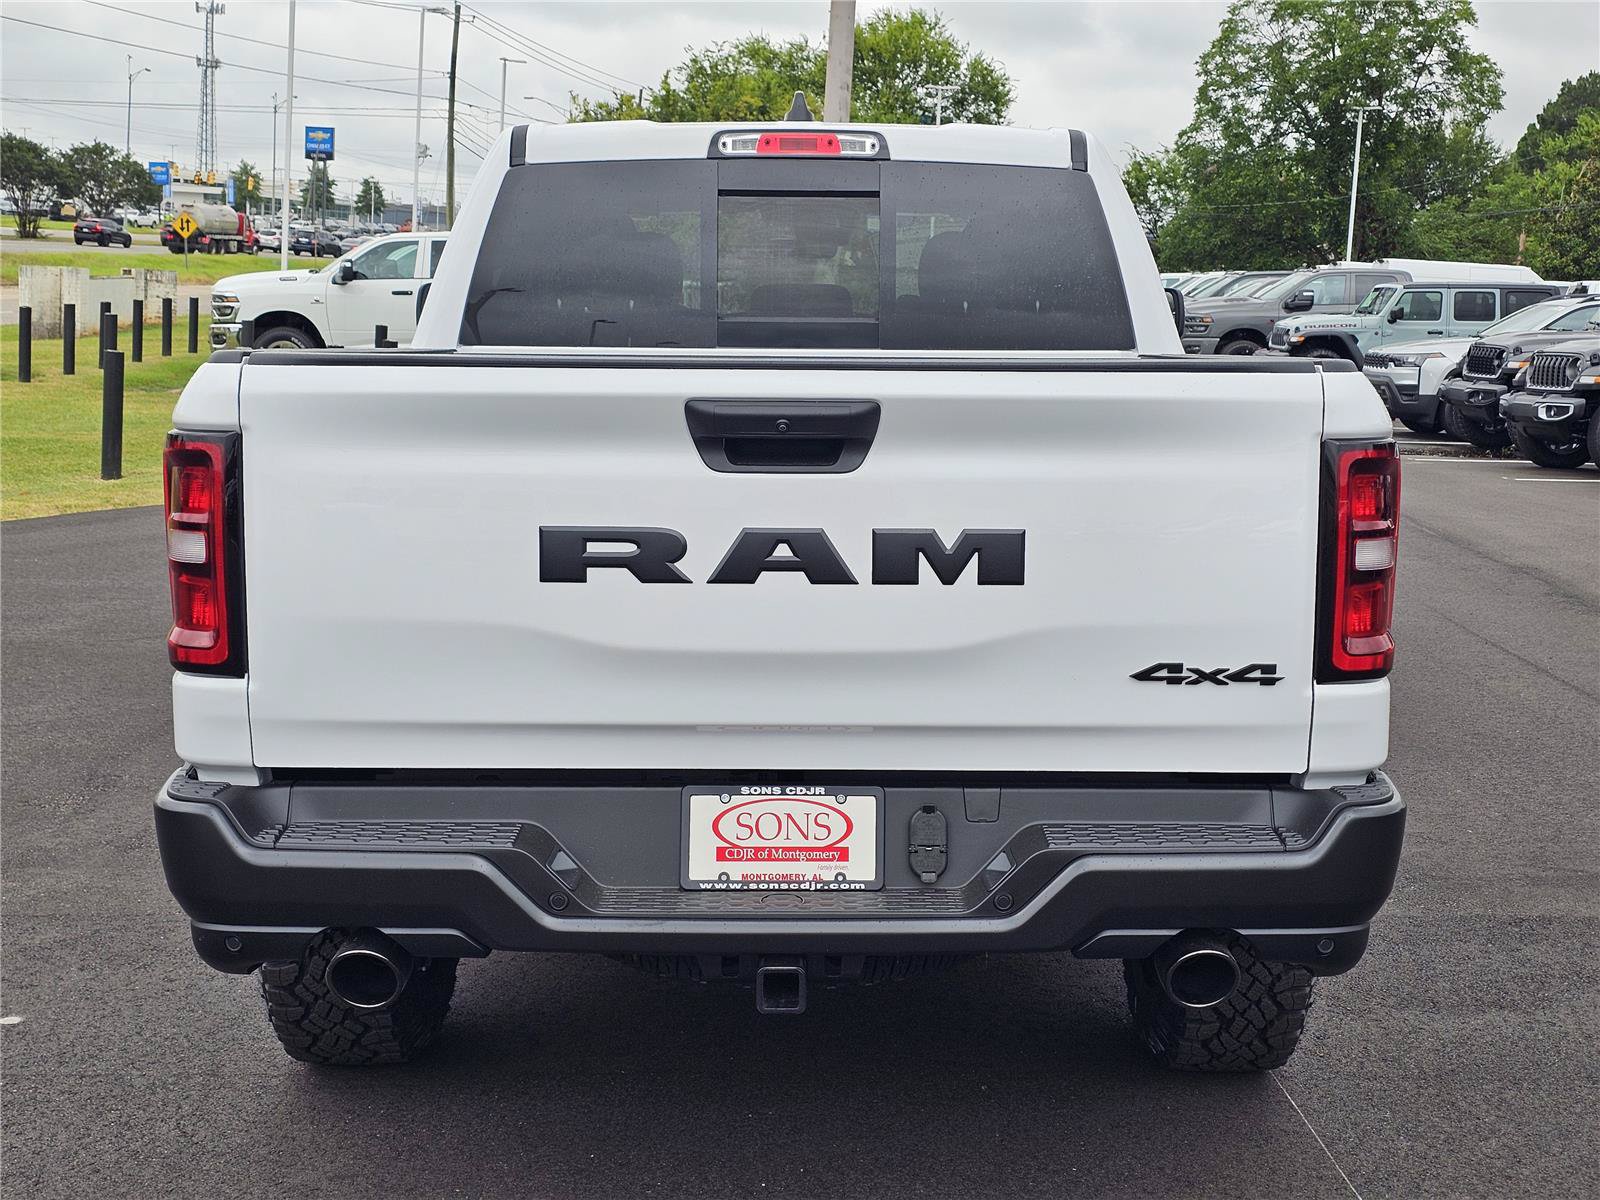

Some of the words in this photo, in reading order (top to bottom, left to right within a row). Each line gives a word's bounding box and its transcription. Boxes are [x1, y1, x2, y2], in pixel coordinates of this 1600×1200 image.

[539, 526, 1025, 585] RAM
[1129, 662, 1286, 686] 4x4
[740, 786, 782, 795] SONS
[785, 786, 826, 795] CDJR
[736, 812, 832, 841] SONS
[725, 848, 755, 861] CDJR
[757, 848, 769, 859] of
[771, 848, 841, 862] Montgomery
[812, 873, 824, 881] AL
[699, 881, 866, 891] www.sonscdjr.com
